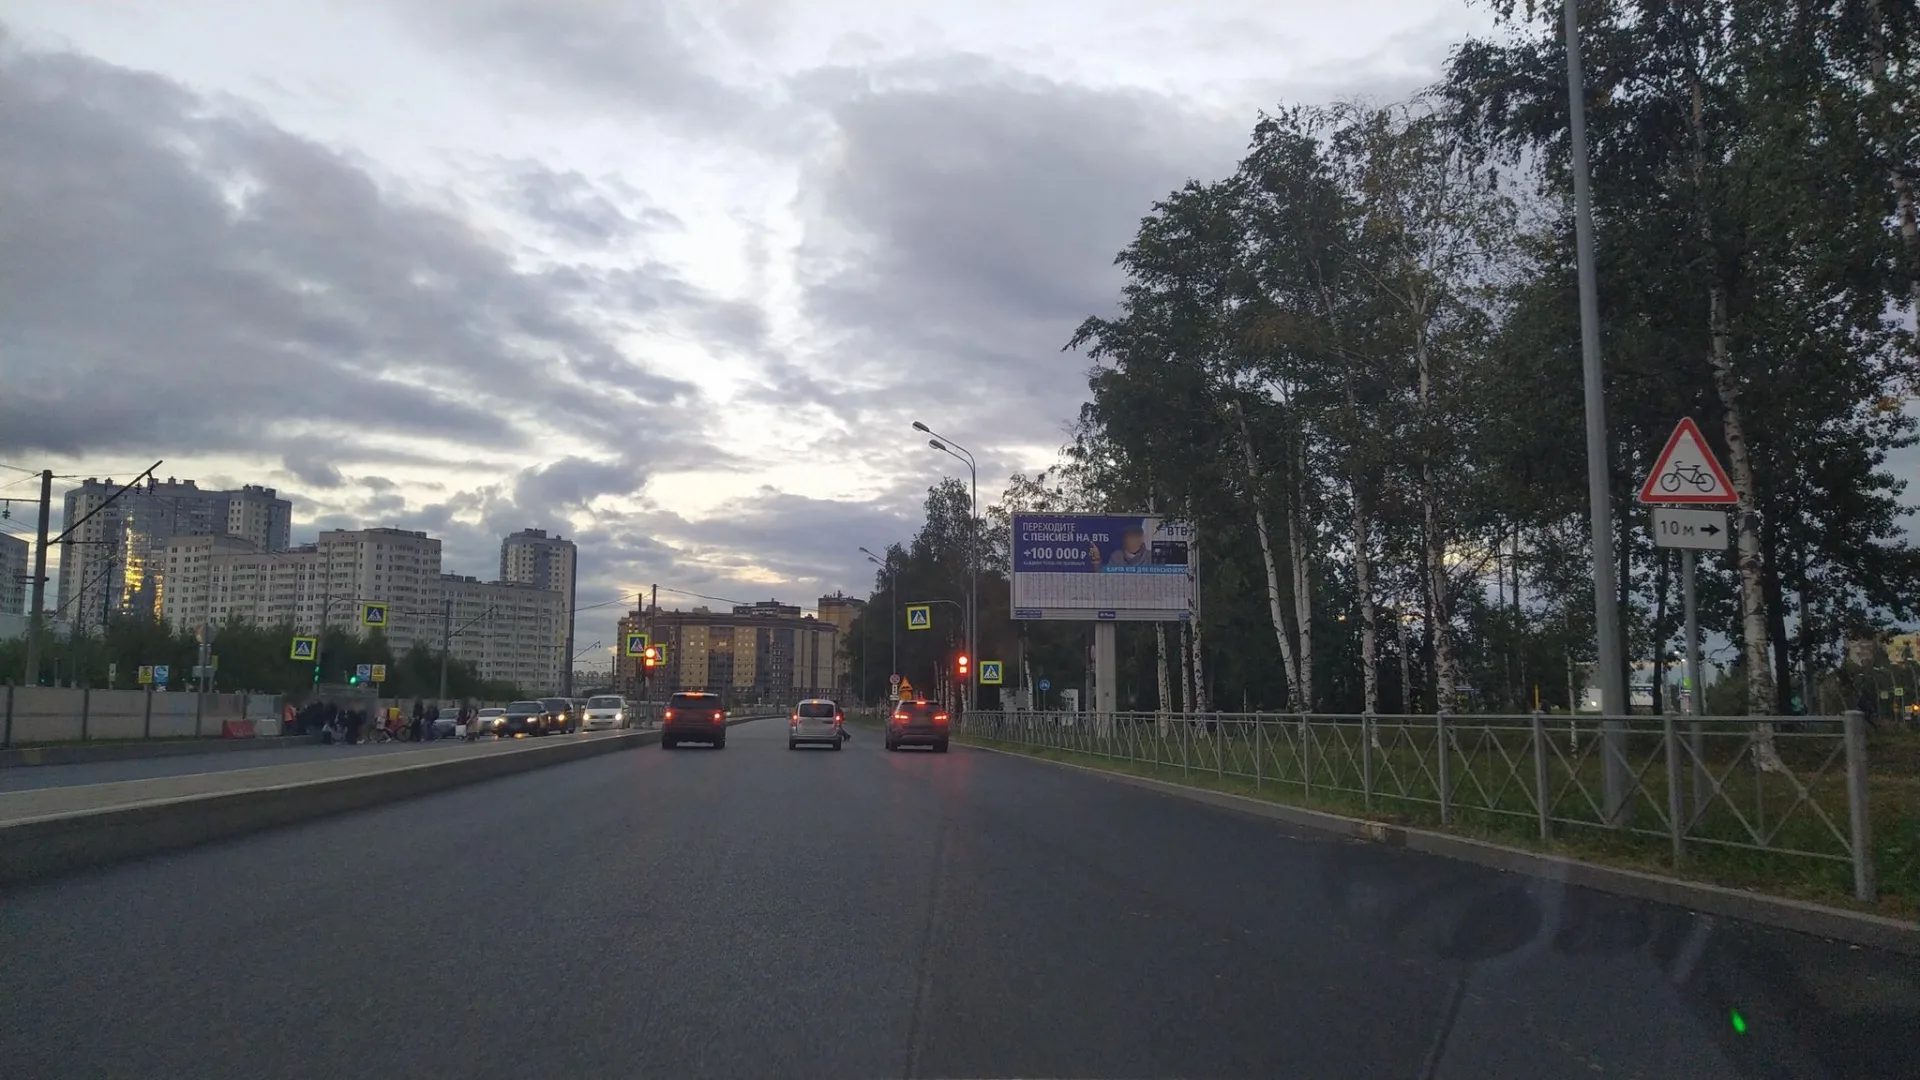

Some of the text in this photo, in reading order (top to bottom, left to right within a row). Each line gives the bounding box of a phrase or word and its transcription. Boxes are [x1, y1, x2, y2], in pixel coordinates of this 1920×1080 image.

[1022, 522, 1076, 532] ПЕРЕХОДИТЕ
[1022, 531, 1110, 542] С ПЕНСИЕЙ НА ВТБ
[1023, 547, 1053, 559] +100
[1056, 547, 1079, 559] 000
[1149, 566, 1188, 574] ПЕНСИОНЕРО
